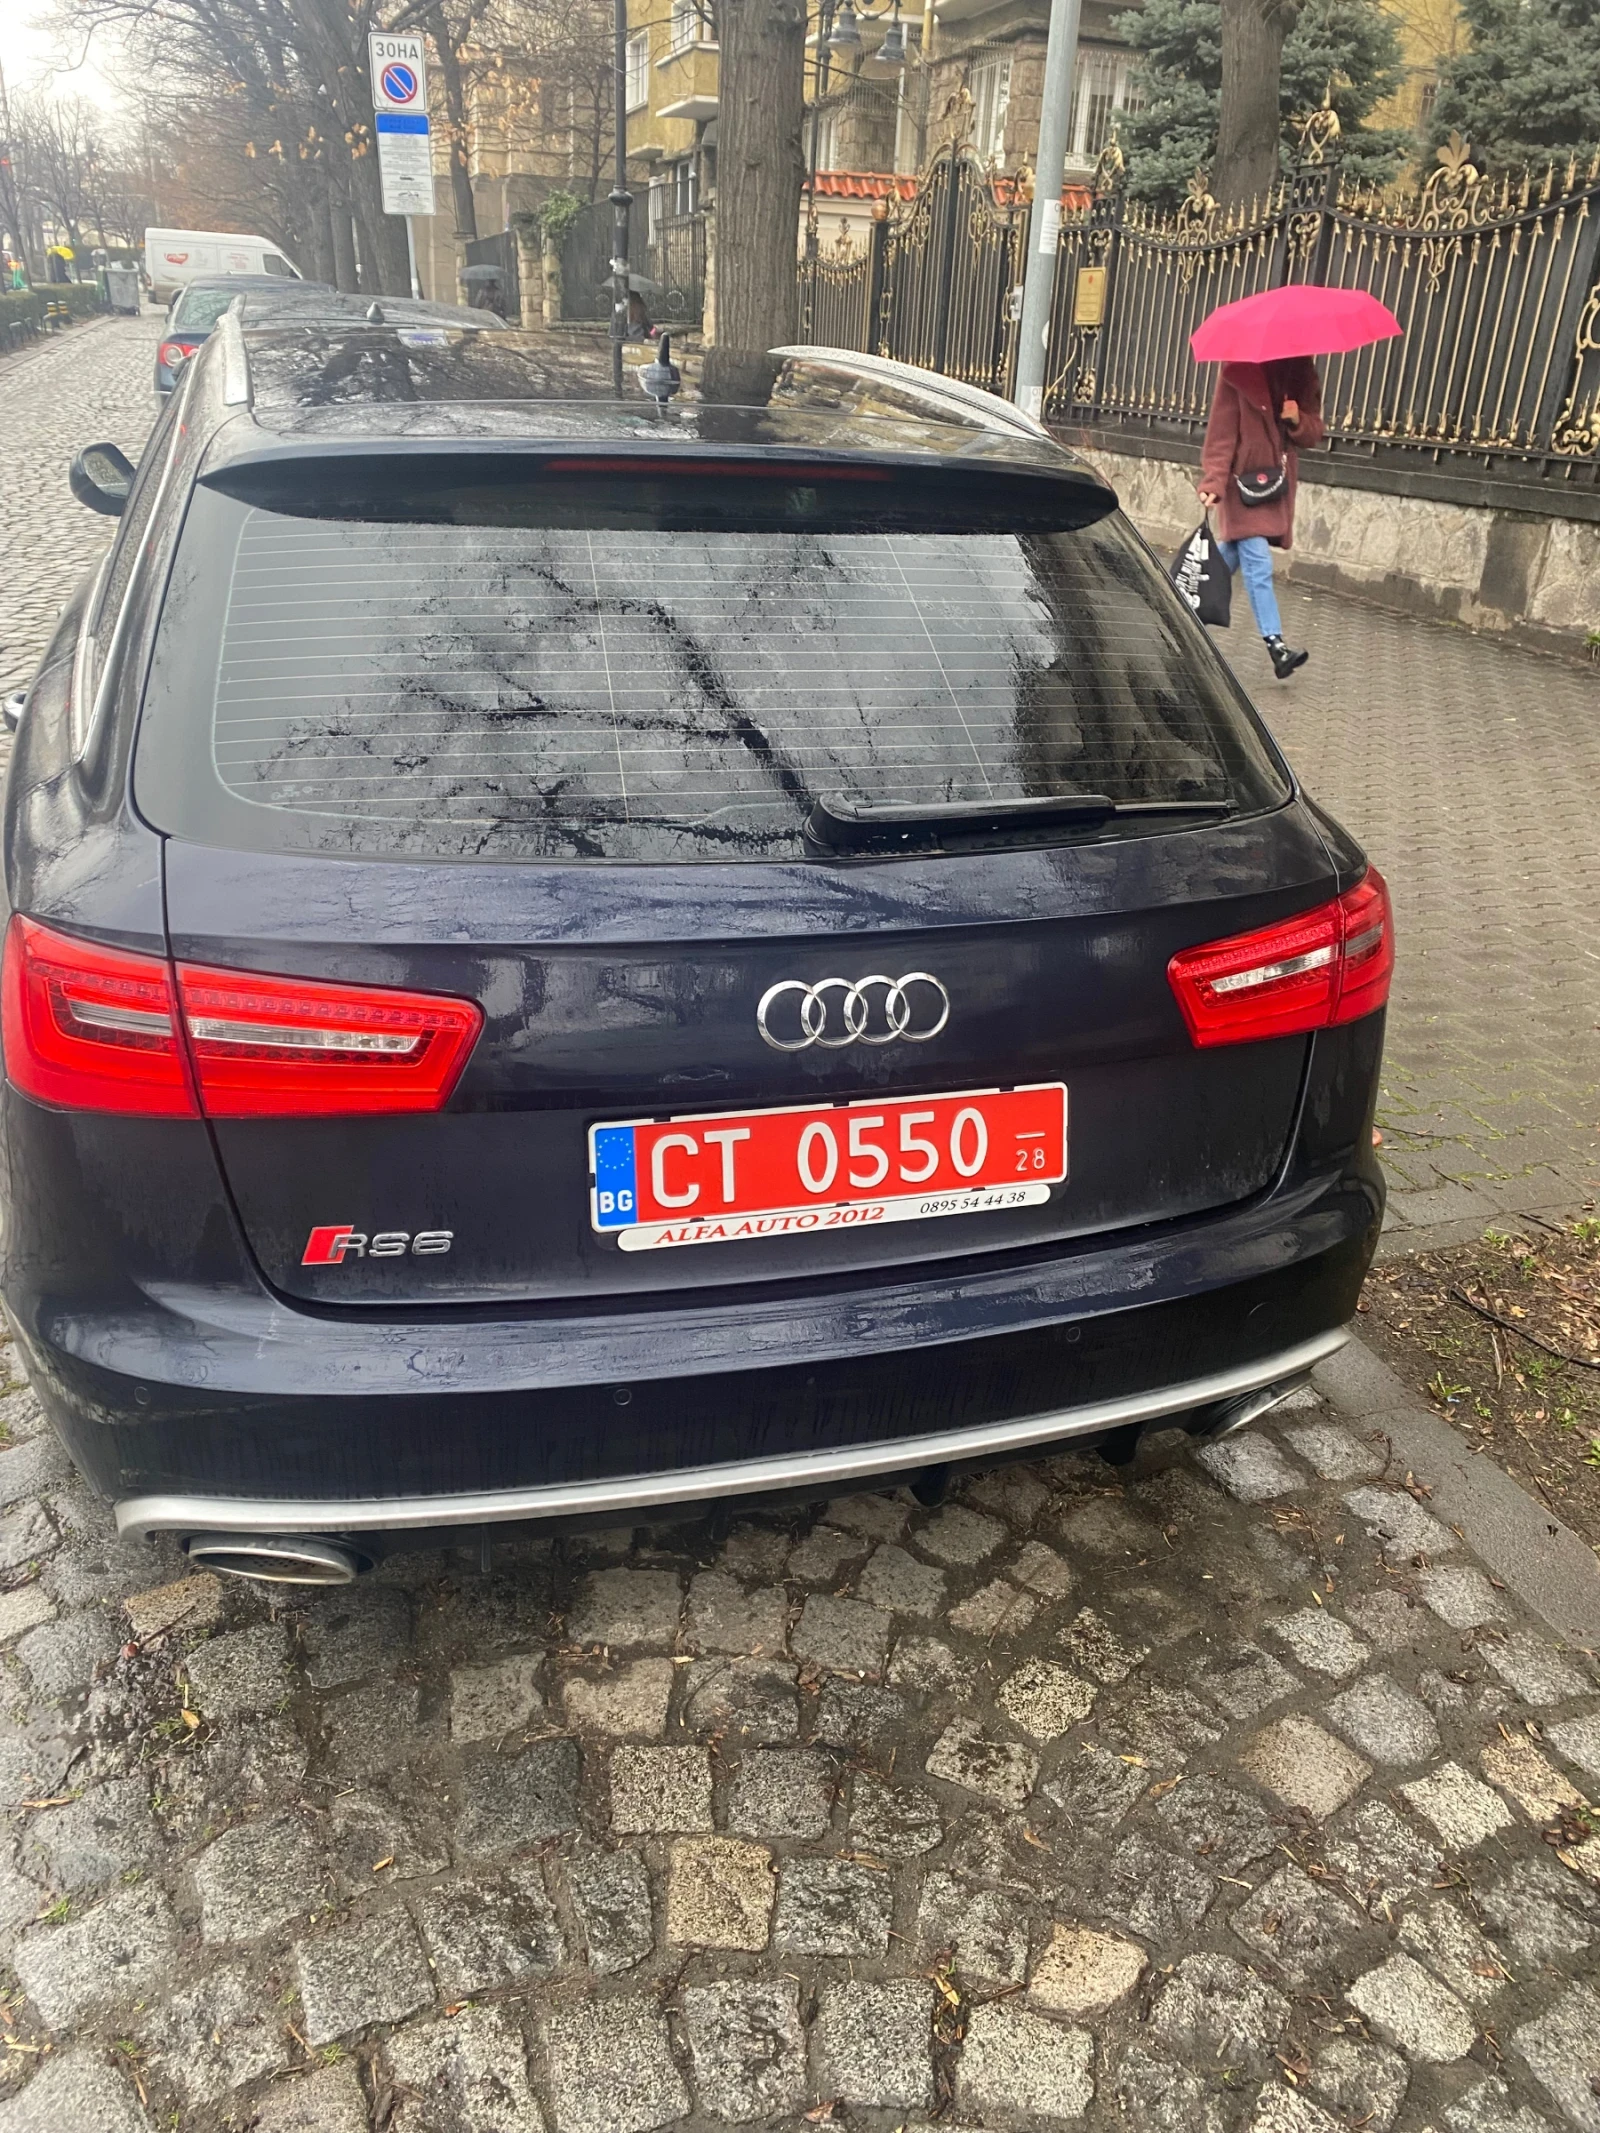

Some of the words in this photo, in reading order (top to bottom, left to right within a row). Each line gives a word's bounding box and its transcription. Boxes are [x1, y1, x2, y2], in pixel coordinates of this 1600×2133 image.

[375, 41, 419, 59] ЗОНА
[651, 1128, 751, 1209] CT
[797, 1107, 989, 1194] 0550
[1015, 1147, 1046, 1172] 28
[600, 1188, 633, 1214] BG
[920, 1199, 958, 1214] 0895
[960, 1197, 980, 1210] 54
[984, 1193, 1003, 1206] 44
[1006, 1191, 1026, 1204] 38
[653, 1223, 728, 1244] ALFA
[732, 1213, 819, 1236] AUTO
[824, 1206, 885, 1226] 2012
[328, 1231, 454, 1259] RS6
